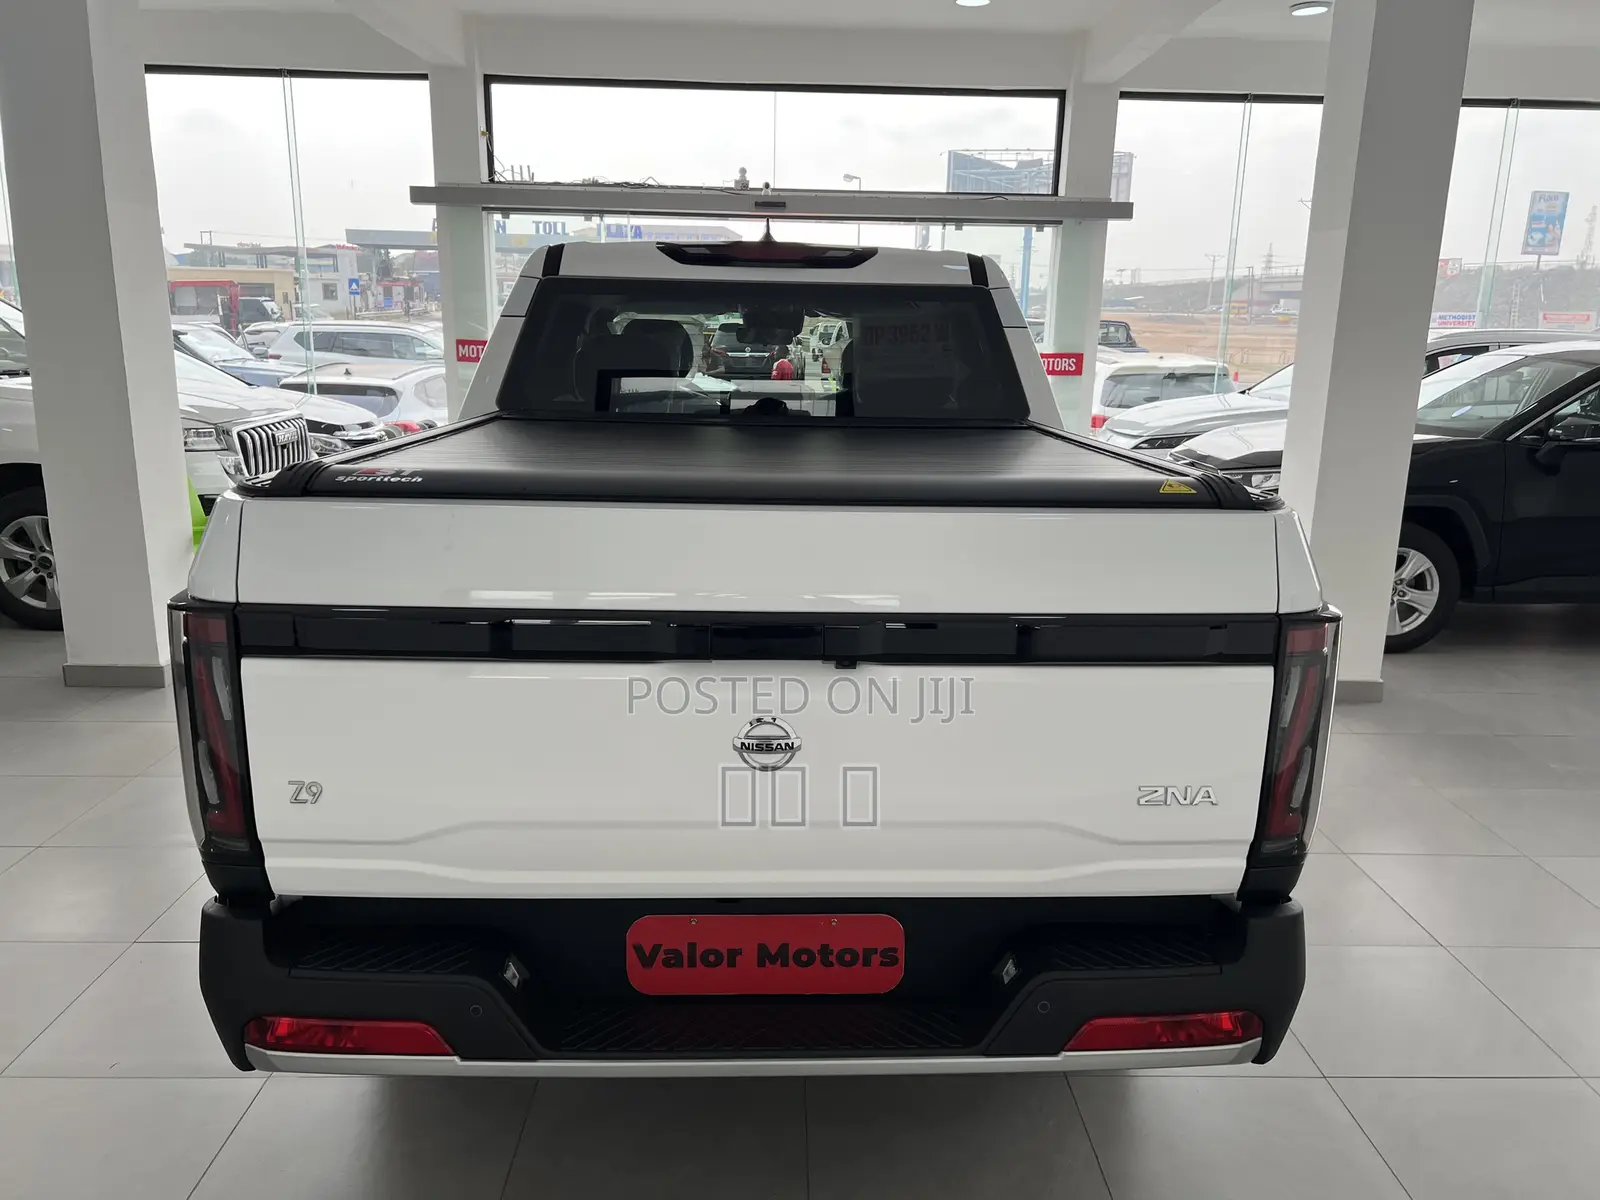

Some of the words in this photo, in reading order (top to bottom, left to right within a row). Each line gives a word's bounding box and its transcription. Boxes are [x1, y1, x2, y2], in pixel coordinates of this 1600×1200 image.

[532, 220, 569, 235] TOLL
[334, 475, 423, 483] sporttech
[740, 741, 795, 752] NISSAN
[287, 780, 323, 805] Z9
[1137, 785, 1218, 806] ZNA
[632, 942, 743, 970] Valor
[756, 942, 900, 969] Motors
